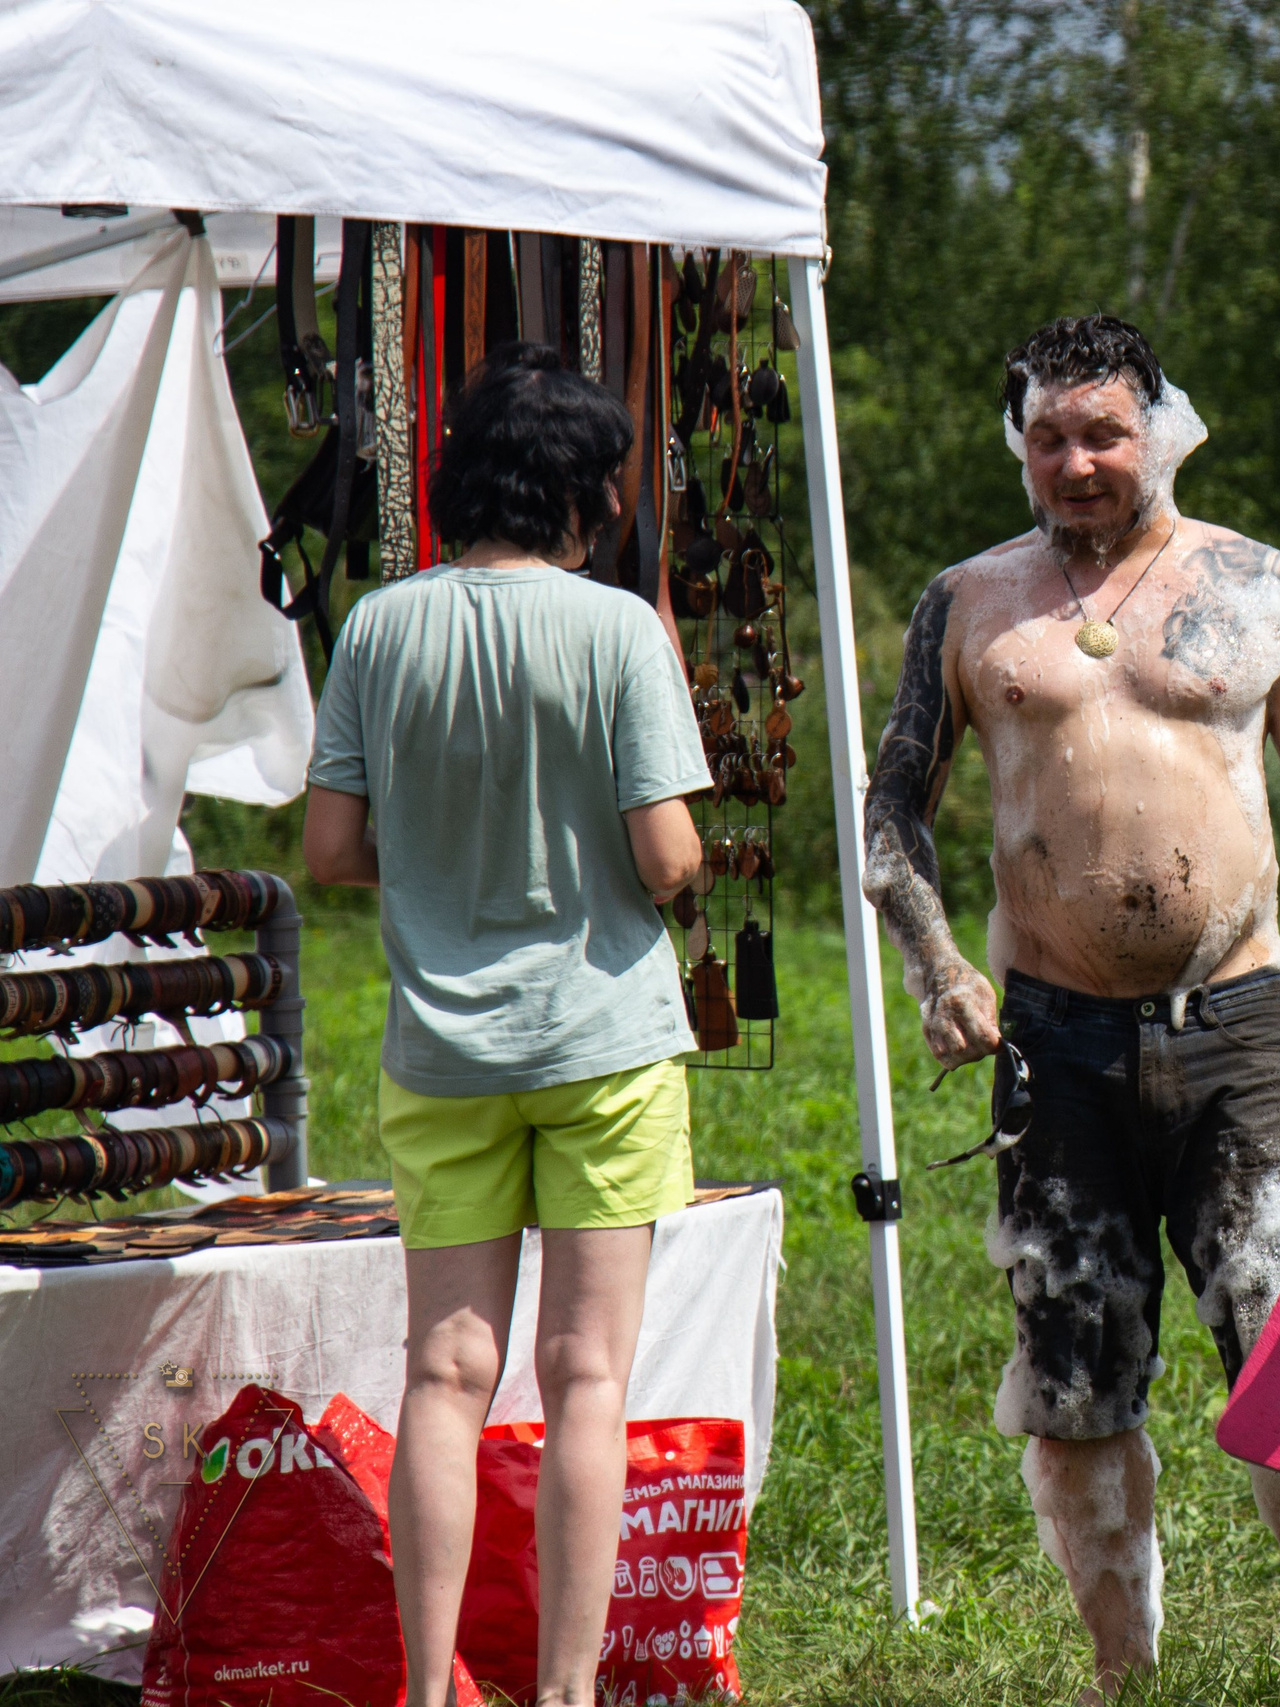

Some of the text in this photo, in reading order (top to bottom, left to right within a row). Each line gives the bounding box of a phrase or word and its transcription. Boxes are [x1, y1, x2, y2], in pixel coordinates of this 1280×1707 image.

[622, 1478, 674, 1503] ЕМЬЯ
[620, 1498, 745, 1541] МАГНИТ
[214, 1660, 310, 1682] okmarket.ru
